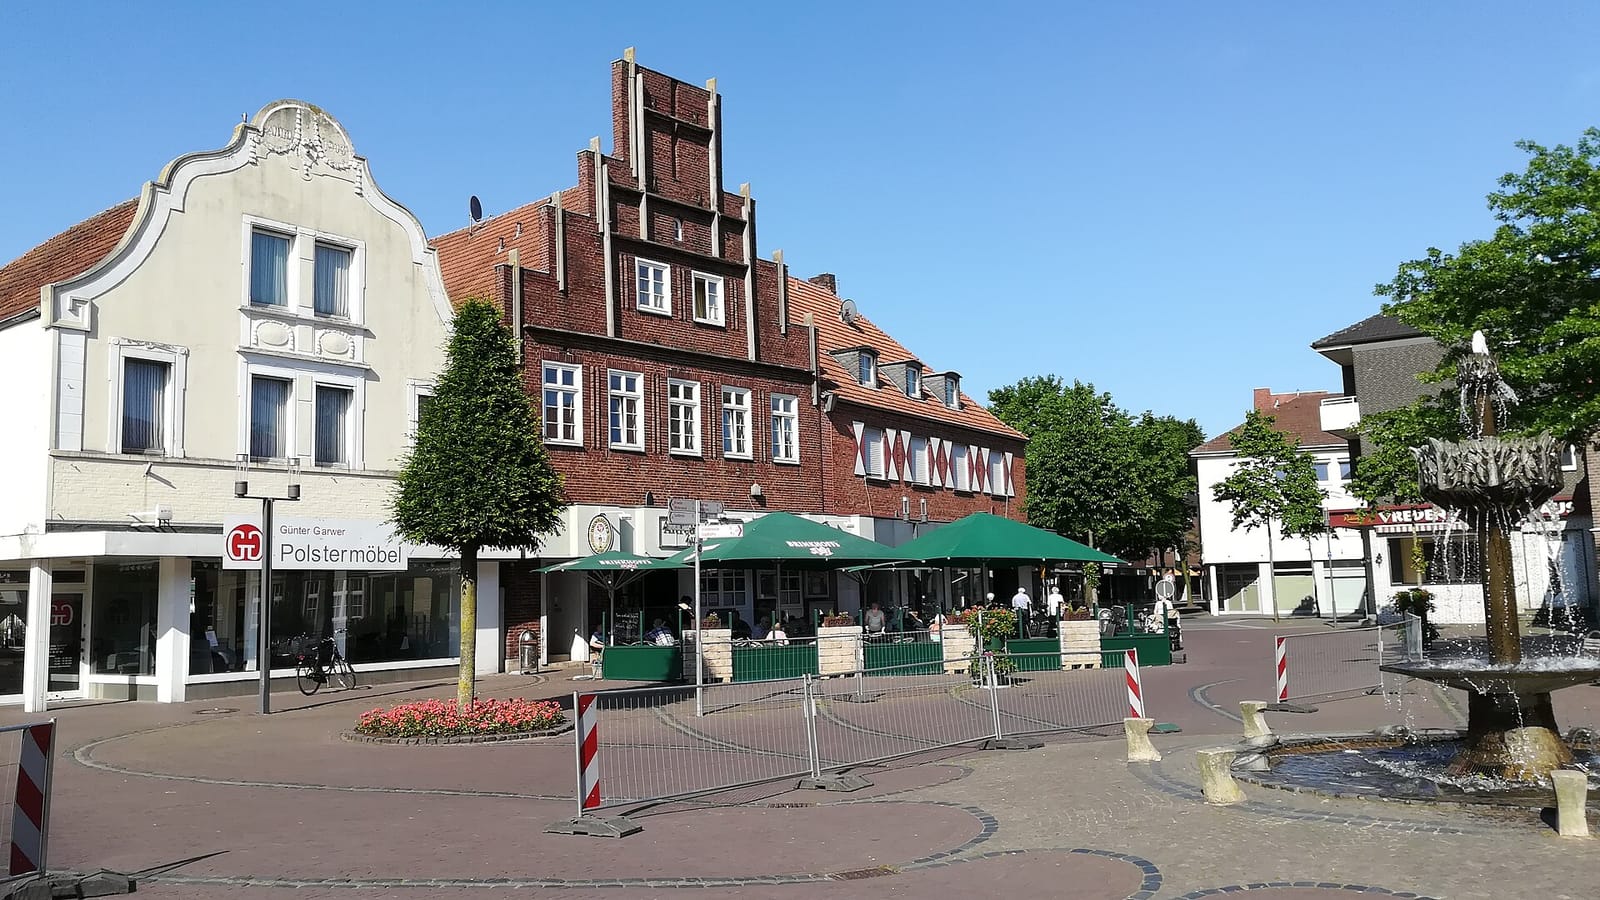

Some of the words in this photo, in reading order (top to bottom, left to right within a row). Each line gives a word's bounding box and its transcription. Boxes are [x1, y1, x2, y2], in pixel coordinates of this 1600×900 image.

[280, 525, 311, 535] Günter
[313, 526, 346, 536] Garwer
[281, 543, 401, 563] Polstermöbel
